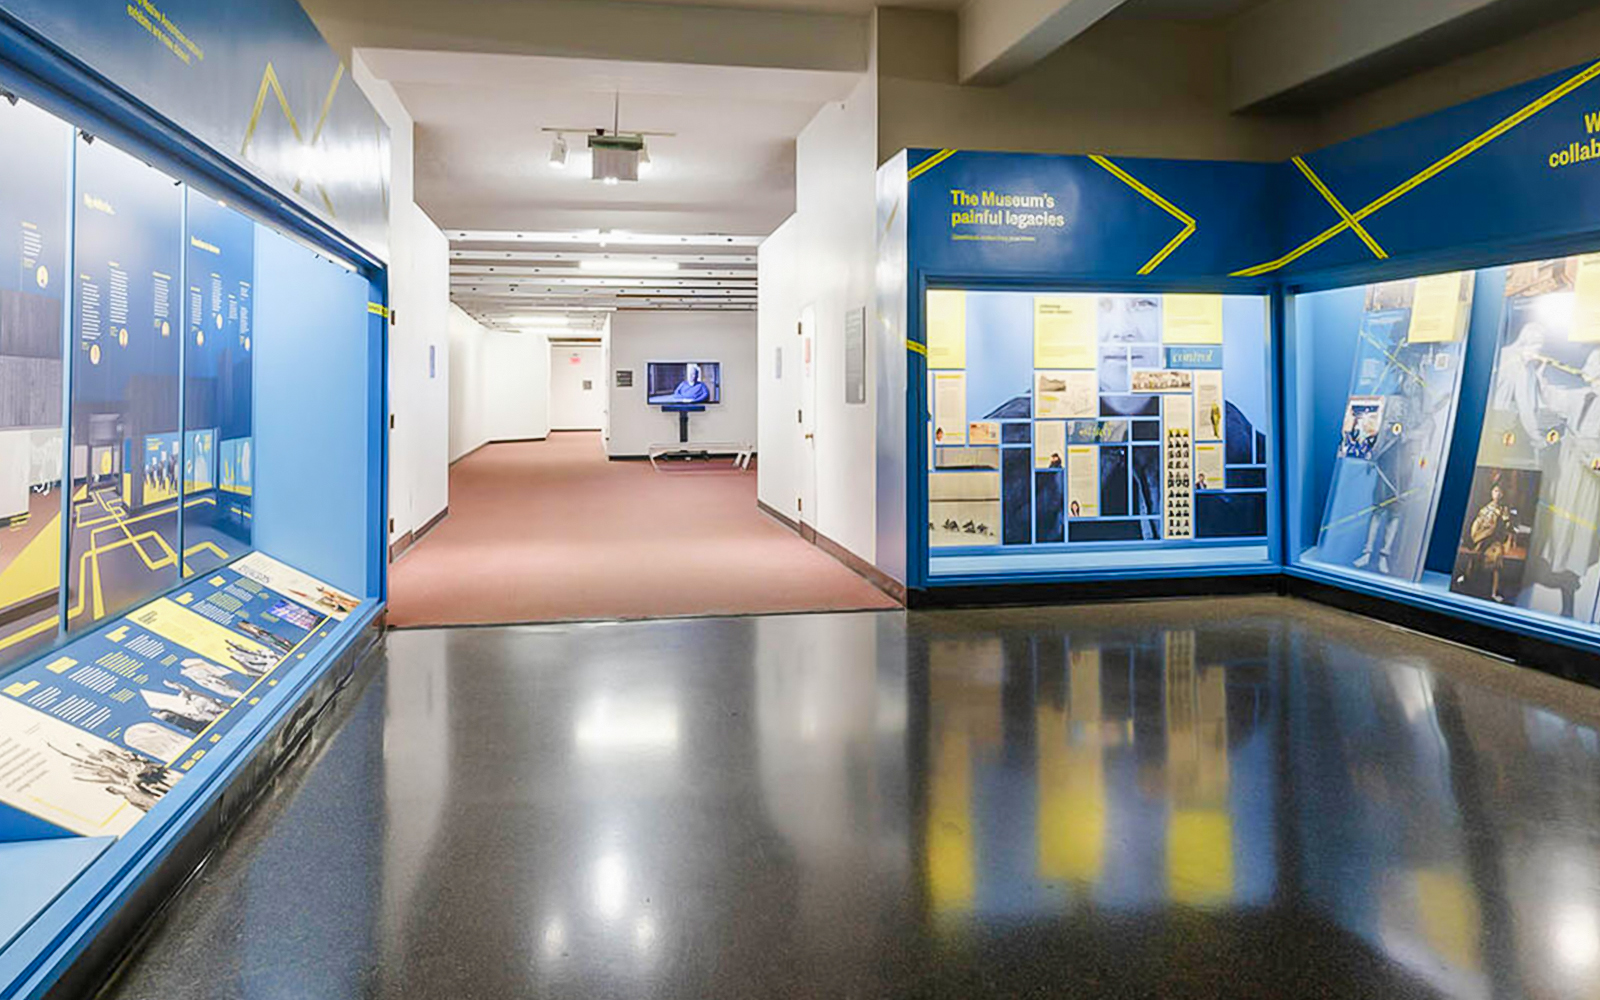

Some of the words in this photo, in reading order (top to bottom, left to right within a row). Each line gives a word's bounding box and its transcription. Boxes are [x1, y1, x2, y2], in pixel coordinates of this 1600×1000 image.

[950, 189, 979, 206] The
[981, 191, 1055, 208] Museum's
[951, 209, 1003, 228] painful
[1005, 211, 1065, 229] legacies
